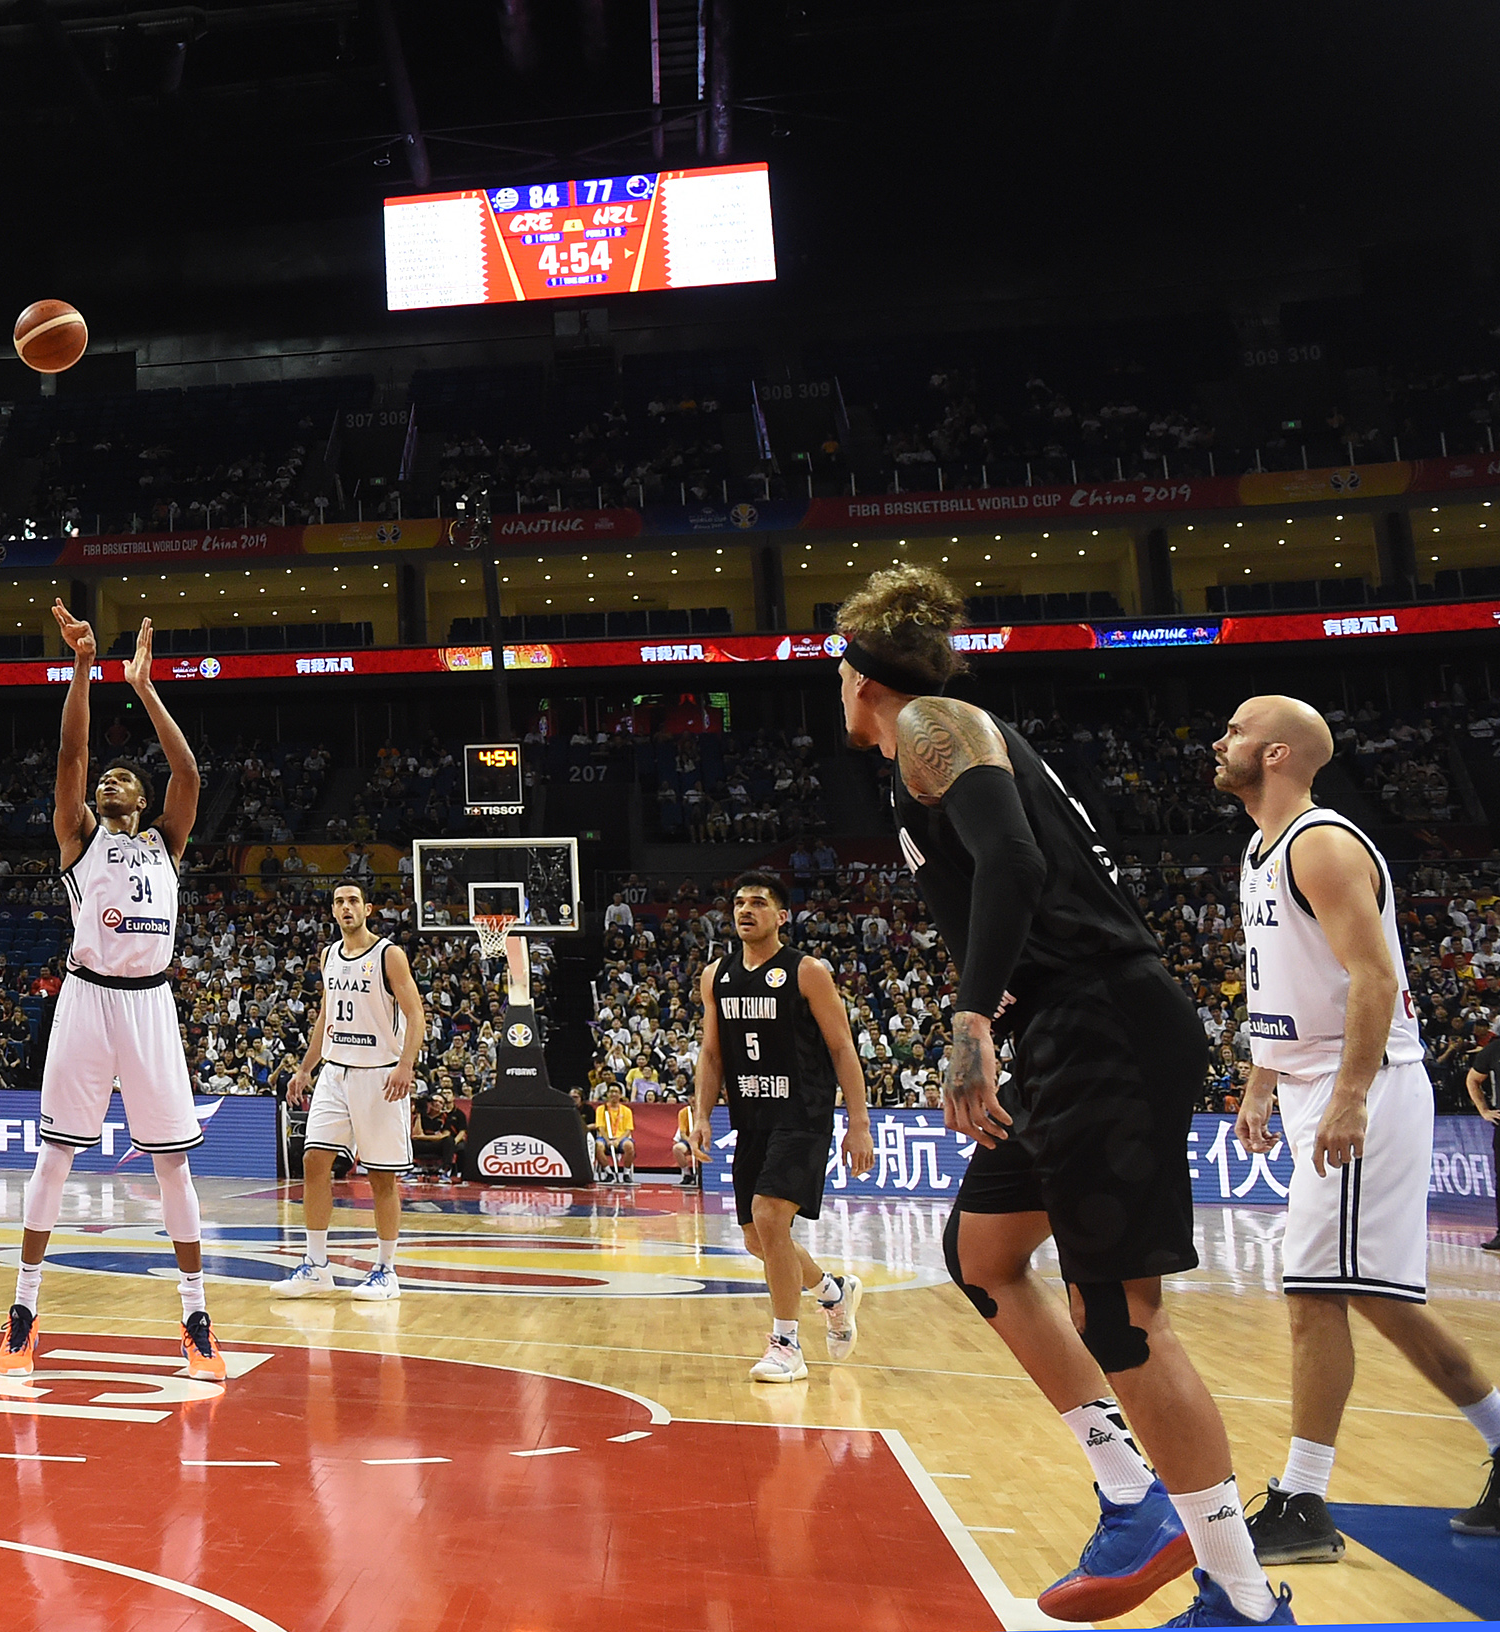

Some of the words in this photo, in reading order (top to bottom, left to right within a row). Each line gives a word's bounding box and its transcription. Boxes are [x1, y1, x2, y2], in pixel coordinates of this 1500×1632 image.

[529, 185, 559, 208] 84
[584, 180, 612, 203] 77
[509, 212, 553, 232] GRE
[593, 204, 637, 225] NZL
[538, 240, 612, 275] 4:54
[345, 413, 374, 428] 307
[379, 410, 408, 426] 308
[849, 504, 881, 517] FIBA
[884, 499, 975, 516] BASKETBALL
[978, 496, 1029, 511] WORLD
[1033, 494, 1062, 508] CUP
[1070, 488, 1136, 508] China
[1142, 484, 1192, 502] 2019
[83, 543, 101, 556] FIBA
[102, 540, 151, 556] BASKETBALL
[153, 539, 180, 553] WORLD
[182, 538, 198, 551] CUP
[201, 535, 238, 552] China
[239, 533, 267, 550] 2019
[1323, 615, 1398, 636] 有我不凡
[948, 634, 1004, 651] 我不凡
[641, 644, 704, 662] 有我不凡
[47, 666, 103, 681] 有我凡
[296, 656, 354, 674] 有我不凡
[478, 750, 517, 767] 4:54
[569, 765, 608, 782] 207
[481, 806, 525, 815] TISSOT
[129, 875, 152, 904] 34
[179, 891, 199, 906] 106
[622, 887, 648, 905] 107
[1250, 947, 1260, 991] 8
[328, 977, 371, 993] ΕΛΛΑΣ
[336, 1000, 353, 1021] 19
[334, 1034, 372, 1045] Eurobank
[745, 1032, 760, 1061] 5
[493, 1142, 544, 1156] 百岁山
[1086, 1433, 1116, 1448] PEAK
[1207, 1507, 1239, 1523] PEAK
